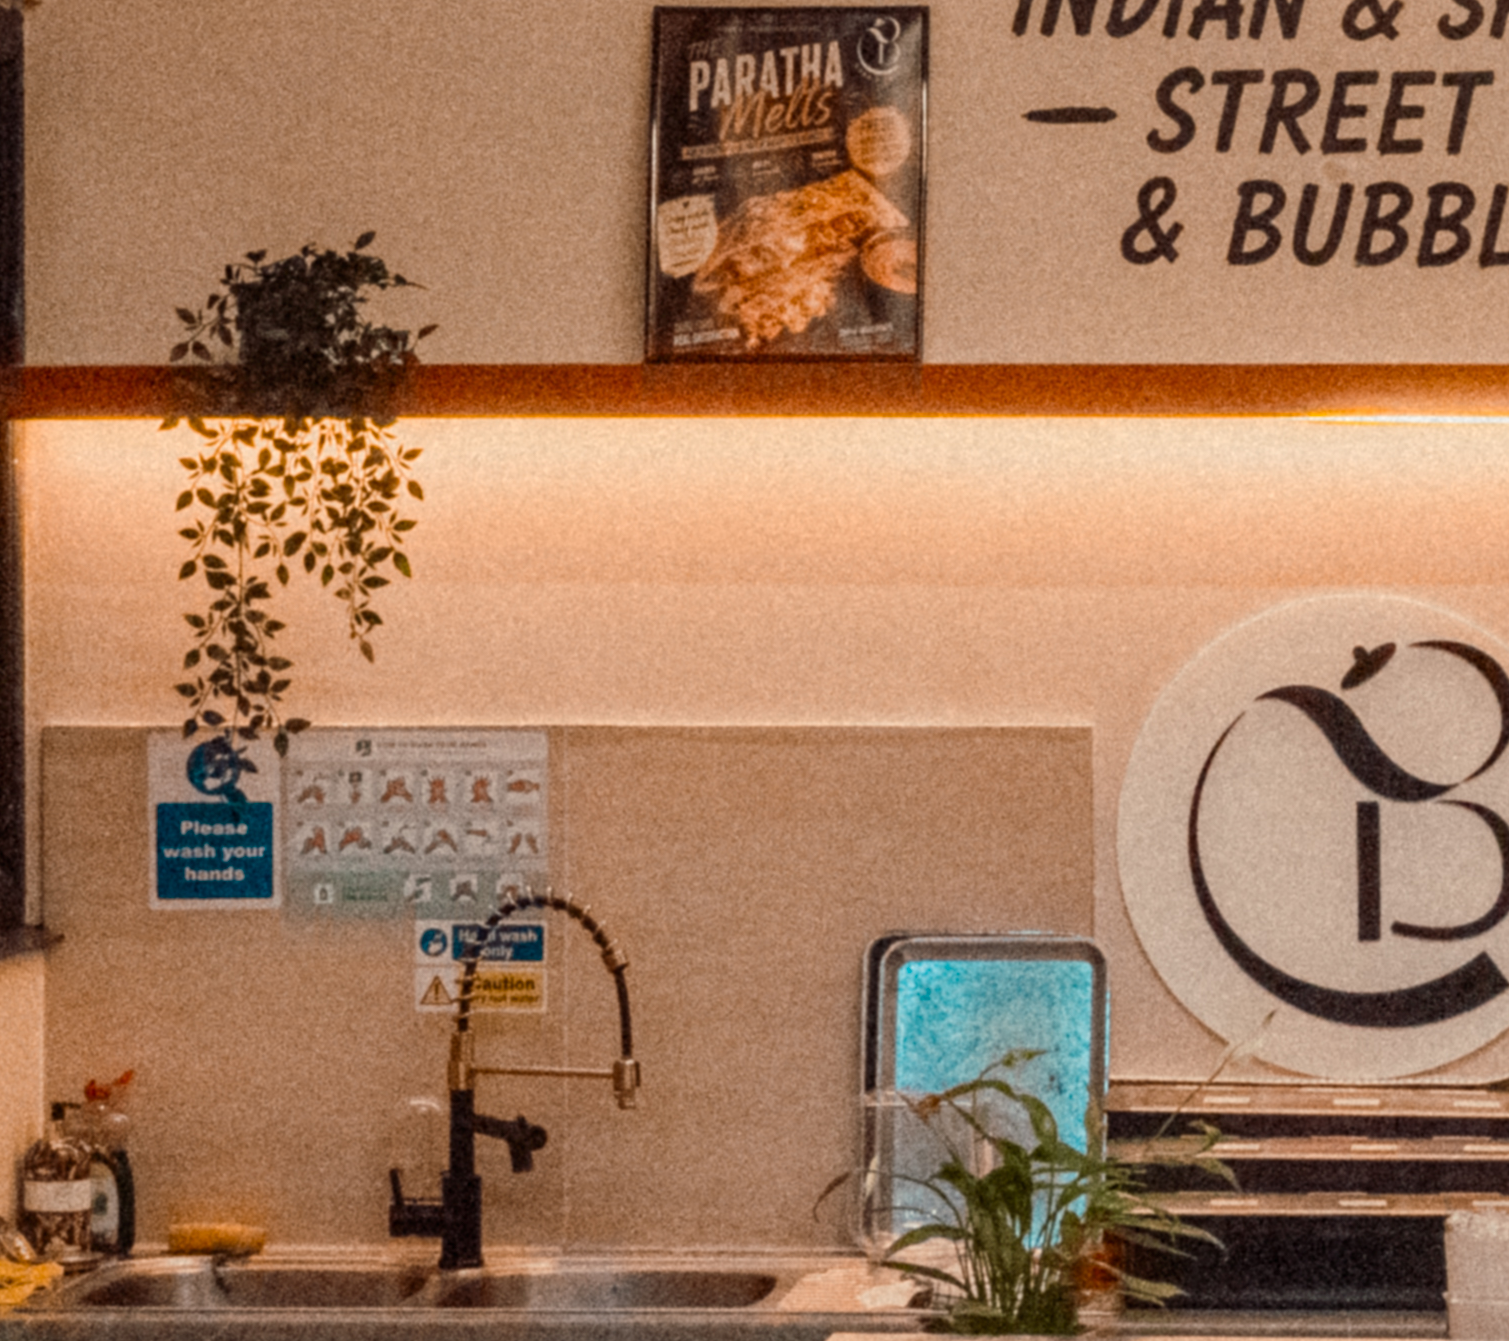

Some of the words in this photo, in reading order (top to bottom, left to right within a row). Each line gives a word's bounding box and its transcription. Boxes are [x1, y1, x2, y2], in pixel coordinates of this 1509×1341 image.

[689, 41, 843, 111] PARATHA
[720, 78, 834, 141] Melts
[1147, 68, 1493, 156] STREET
[1121, 177, 1183, 265] &
[180, 820, 248, 835] Please
[163, 843, 216, 858] wash
[222, 846, 266, 862] your
[184, 866, 245, 881] hands
[459, 928, 496, 943] Had
[500, 929, 538, 943] wash
[484, 945, 515, 961] only
